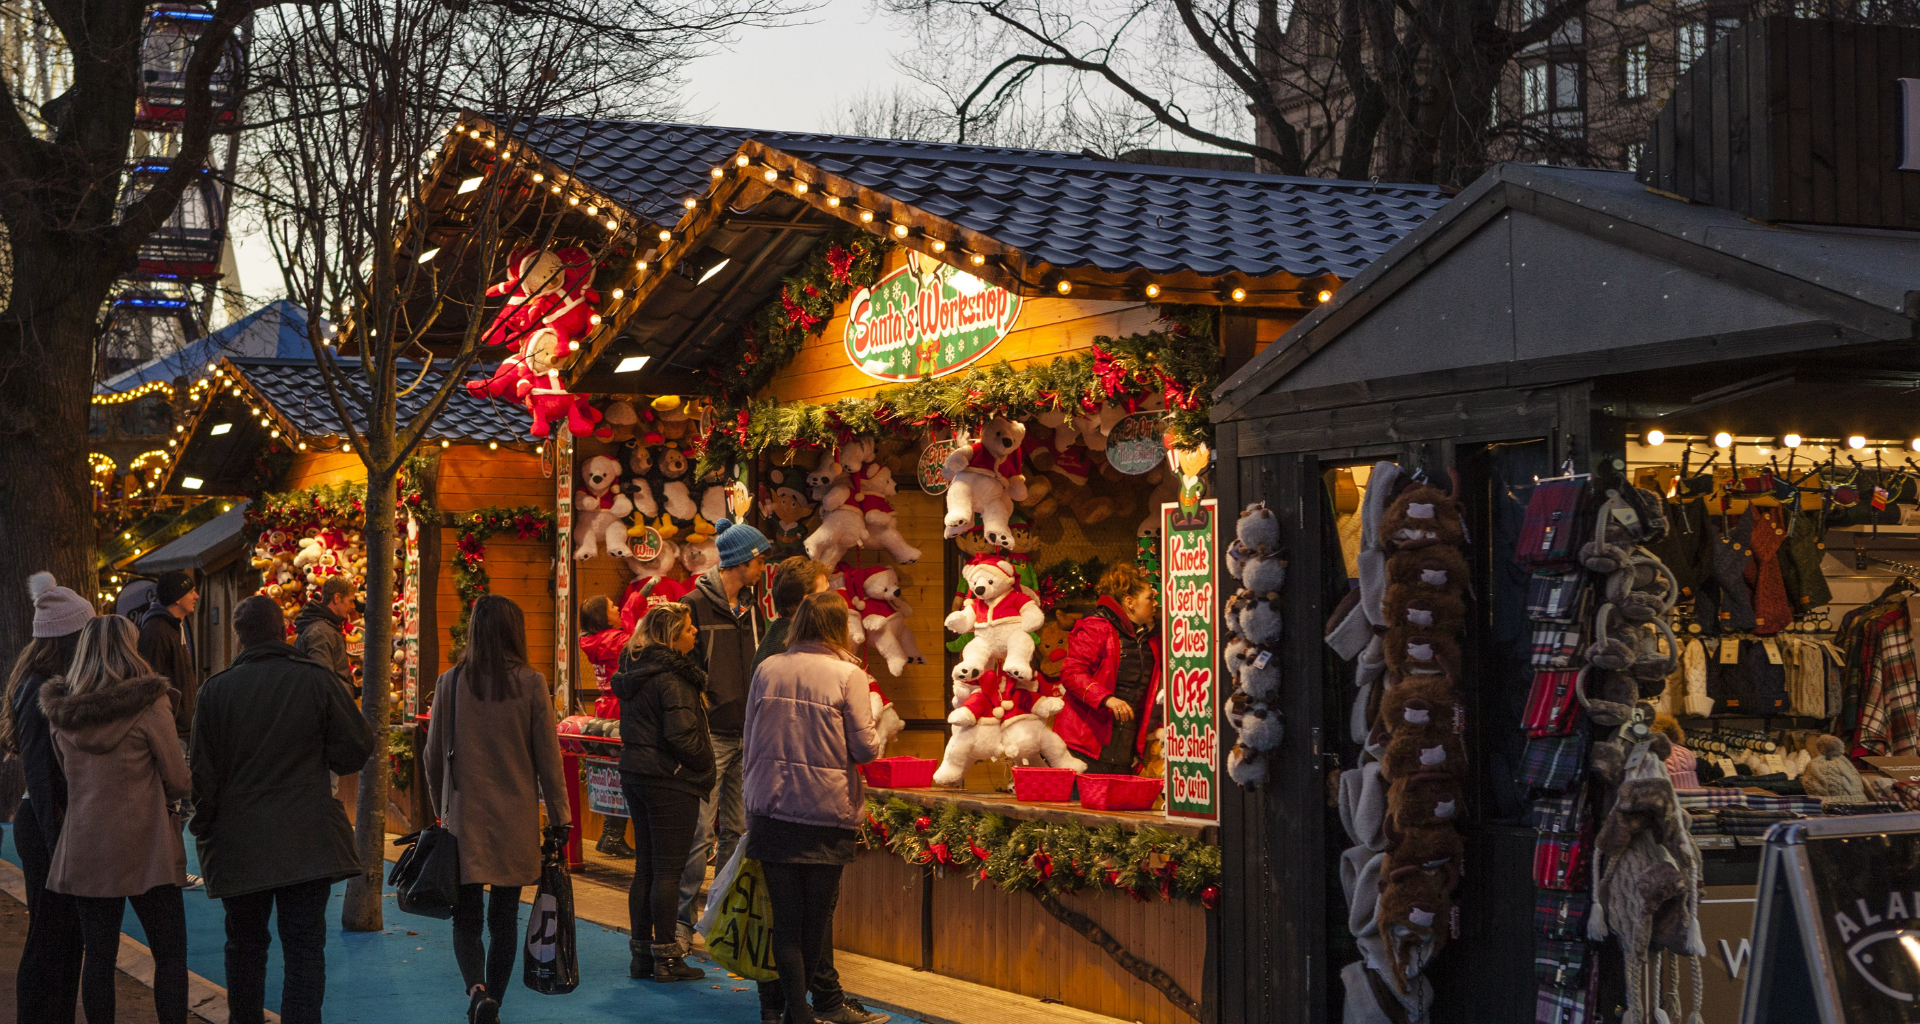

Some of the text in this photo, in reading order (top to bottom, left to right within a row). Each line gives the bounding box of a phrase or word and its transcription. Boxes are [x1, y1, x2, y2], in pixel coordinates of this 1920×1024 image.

[854, 281, 1009, 354] Santa's Workshop
[1170, 537, 1207, 571] Knock
[1168, 578, 1210, 619] 1 set of
[1172, 618, 1206, 653] Elves
[1166, 725, 1215, 767] the shelf
[1173, 769, 1208, 800] to win
